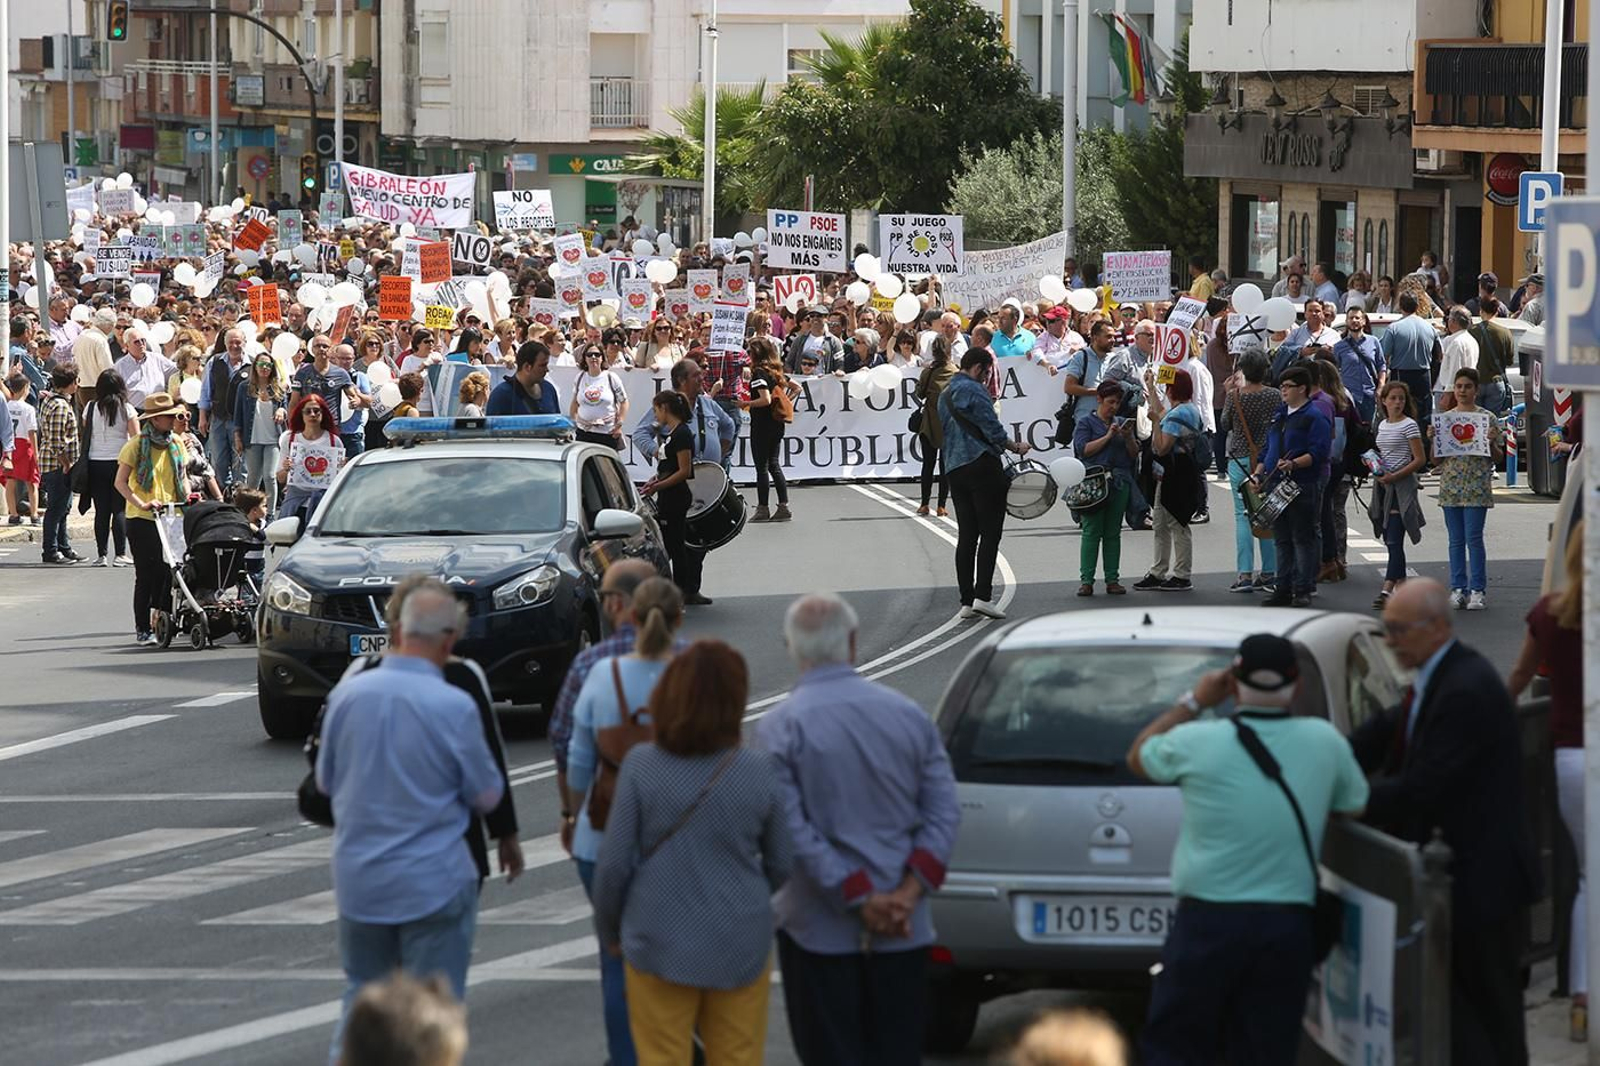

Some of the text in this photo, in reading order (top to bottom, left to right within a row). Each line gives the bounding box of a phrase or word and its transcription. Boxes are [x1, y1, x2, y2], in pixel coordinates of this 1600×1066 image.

[1289, 133, 1319, 166] ROSS
[330, 165, 338, 187] P
[350, 186, 471, 209] NUEVO CENTRO DE
[512, 190, 533, 203] NO
[1527, 180, 1552, 224] P
[352, 198, 400, 221] SALUD
[506, 217, 518, 229] LOS
[521, 216, 554, 228] RECORTES
[775, 213, 838, 232] PP PSOE
[891, 217, 946, 227] SU JUEGO
[771, 232, 843, 252] NO NOS ENGAÑEIS
[890, 232, 903, 241] PP
[98, 248, 131, 258] SE VENDE
[318, 243, 337, 261] NO
[454, 233, 491, 263] NO
[98, 260, 107, 273] TU
[791, 250, 820, 266] MÁS
[887, 263, 958, 273] NUESTRA VIDA
[381, 281, 411, 291] RECORTES
[775, 276, 815, 305] NO
[1556, 223, 1597, 365] P
[1154, 326, 1186, 365] NO
[359, 636, 386, 652] CNP
[1056, 905, 1121, 932] 1015
